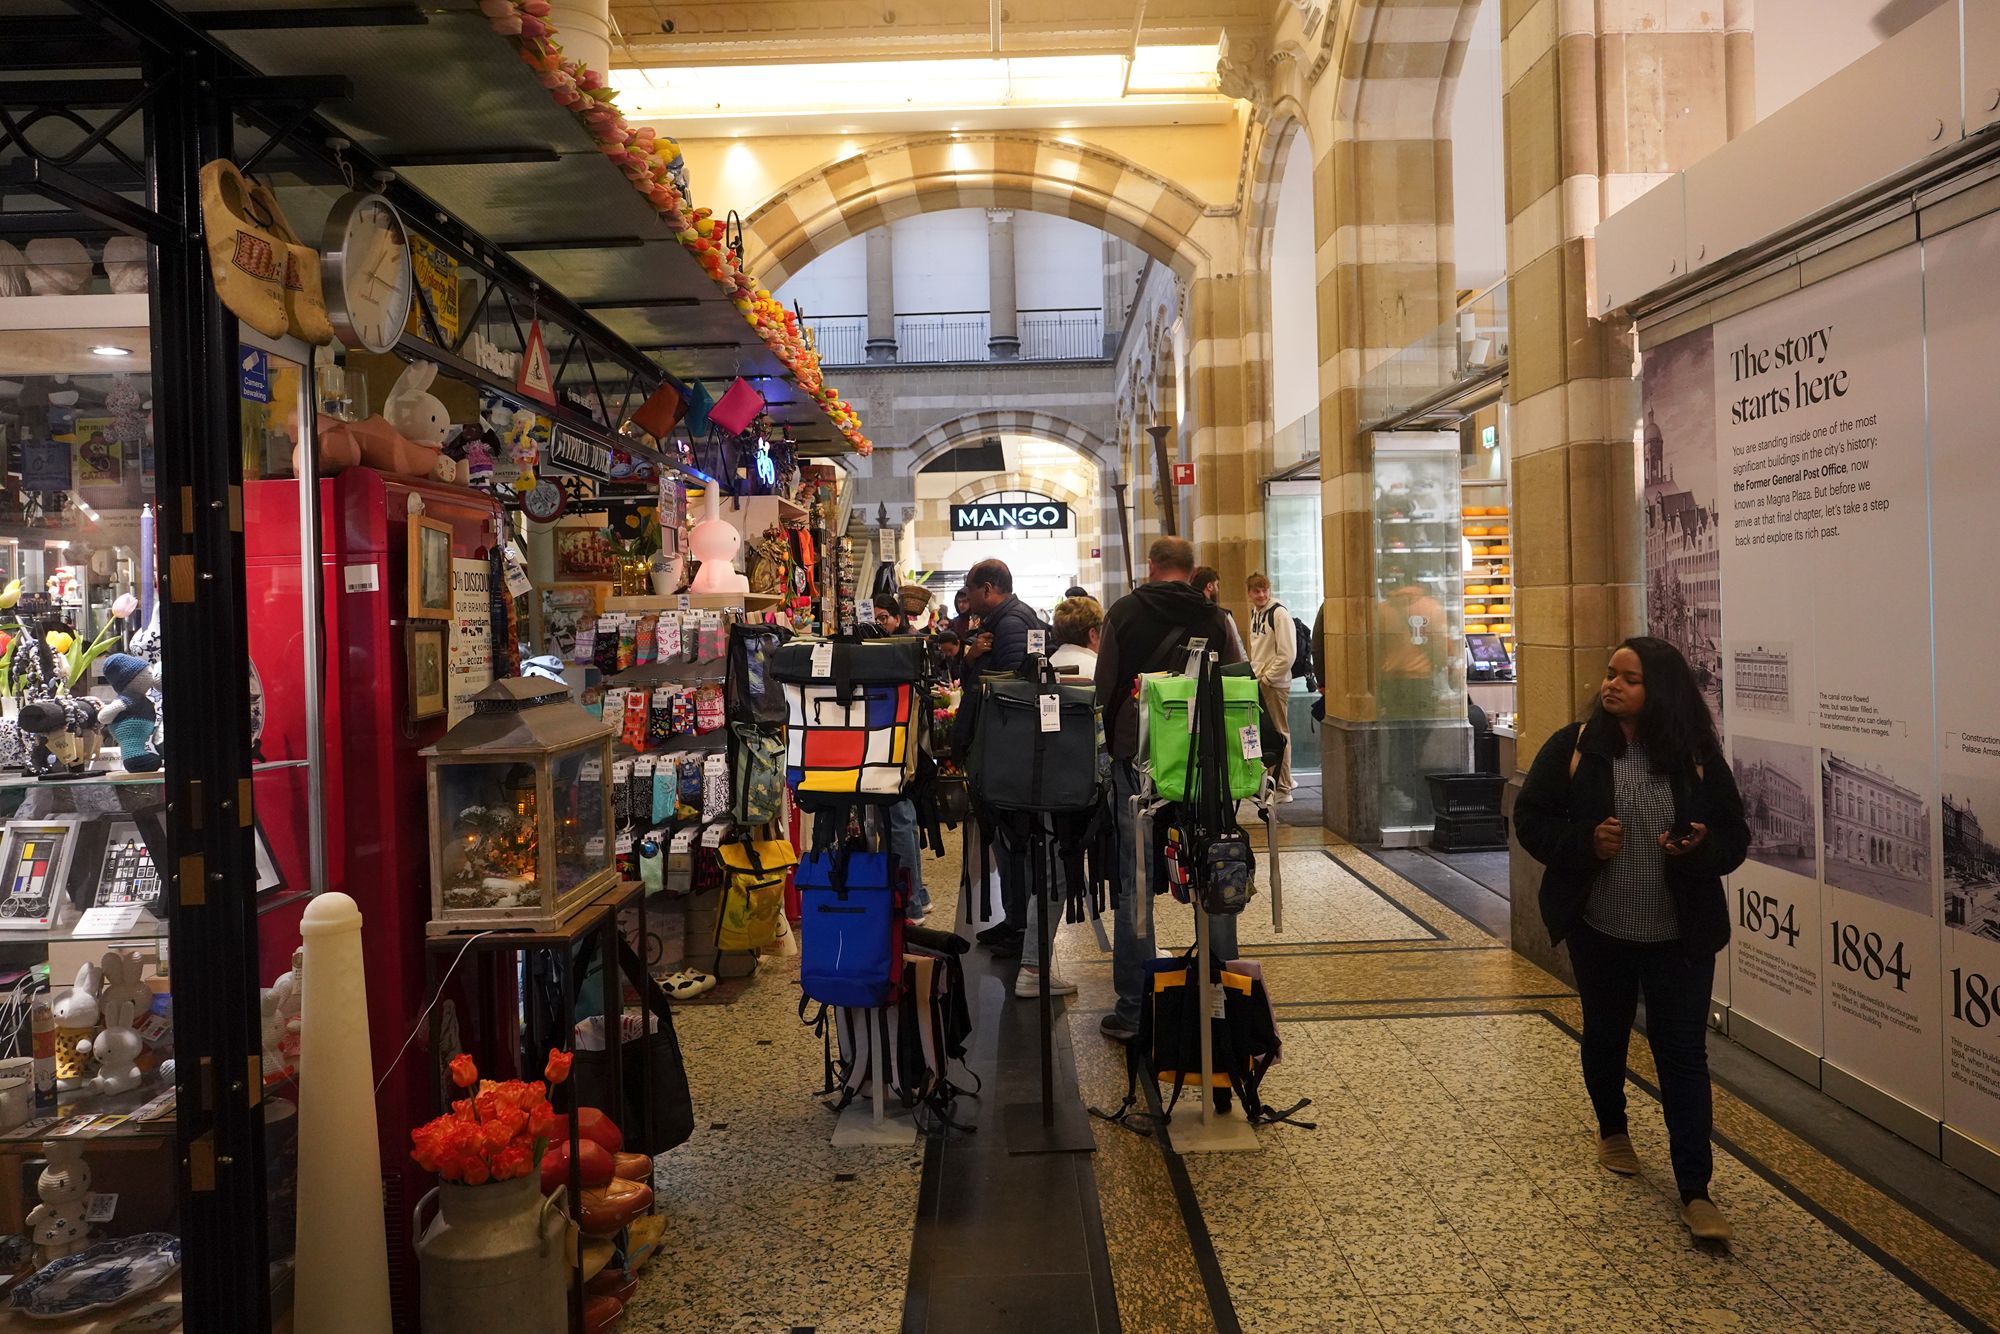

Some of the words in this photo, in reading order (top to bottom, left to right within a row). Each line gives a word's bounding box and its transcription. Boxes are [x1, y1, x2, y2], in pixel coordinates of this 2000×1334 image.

[1730, 343, 1771, 382] The
[1774, 325, 1834, 369] story
[243, 387, 267, 401] bewaking
[244, 376, 265, 389] Camera-
[1731, 386, 1790, 425] starts
[1794, 370, 1850, 409] here
[1732, 445, 1745, 456] You
[1746, 443, 1756, 454] are
[1758, 435, 1788, 451] standing
[1789, 429, 1811, 444] inside
[1812, 427, 1827, 438] one
[1829, 420, 1838, 434] of
[1840, 419, 1853, 432] the
[1855, 413, 1877, 428] most
[561, 432, 589, 467] TYPICAL
[1733, 460, 1766, 476] significant
[1767, 453, 1800, 468] buildings
[1802, 449, 1808, 461] in
[1810, 446, 1822, 459] the
[1824, 441, 1845, 456] city's
[1847, 437, 1878, 451] history:
[1733, 481, 1745, 492] the
[1746, 478, 1771, 490] Former
[1772, 469, 1801, 486] General
[1803, 467, 1820, 481] Post
[1821, 463, 1849, 477] Office,
[1851, 460, 1869, 472] now
[1734, 499, 1755, 510] known
[1757, 498, 1764, 507] as
[1766, 494, 1790, 507] Magna
[1814, 486, 1828, 498] But
[1829, 481, 1856, 496] before
[1858, 480, 1871, 491] we
[958, 506, 1060, 527] MANGO
[1734, 518, 1752, 528] arrive
[1754, 516, 1761, 526] at
[1762, 513, 1775, 525] that
[1777, 509, 1792, 523] final
[1793, 507, 1824, 522] chapter,
[1825, 504, 1841, 517] let's
[1843, 501, 1861, 515] take
[1862, 502, 1868, 512] a
[1870, 499, 1890, 512] step
[1735, 533, 1750, 546] back
[1752, 531, 1765, 545] and
[1767, 530, 1793, 545] explore
[1794, 529, 1803, 541] its
[1805, 526, 1819, 540] rich
[1821, 525, 1840, 540] past.
[1962, 744, 1981, 754] Palace
[1737, 887, 1800, 949] 1854
[1830, 920, 1911, 993] 1884
[1951, 1036, 1963, 1048] This
[1963, 1042, 1981, 1057] grand
[1952, 1047, 1966, 1062] 1894,
[1968, 1057, 1984, 1070] when
[1985, 1062, 1990, 1072] it
[1951, 1058, 1959, 1069] for
[1960, 1063, 1971, 1074] the
